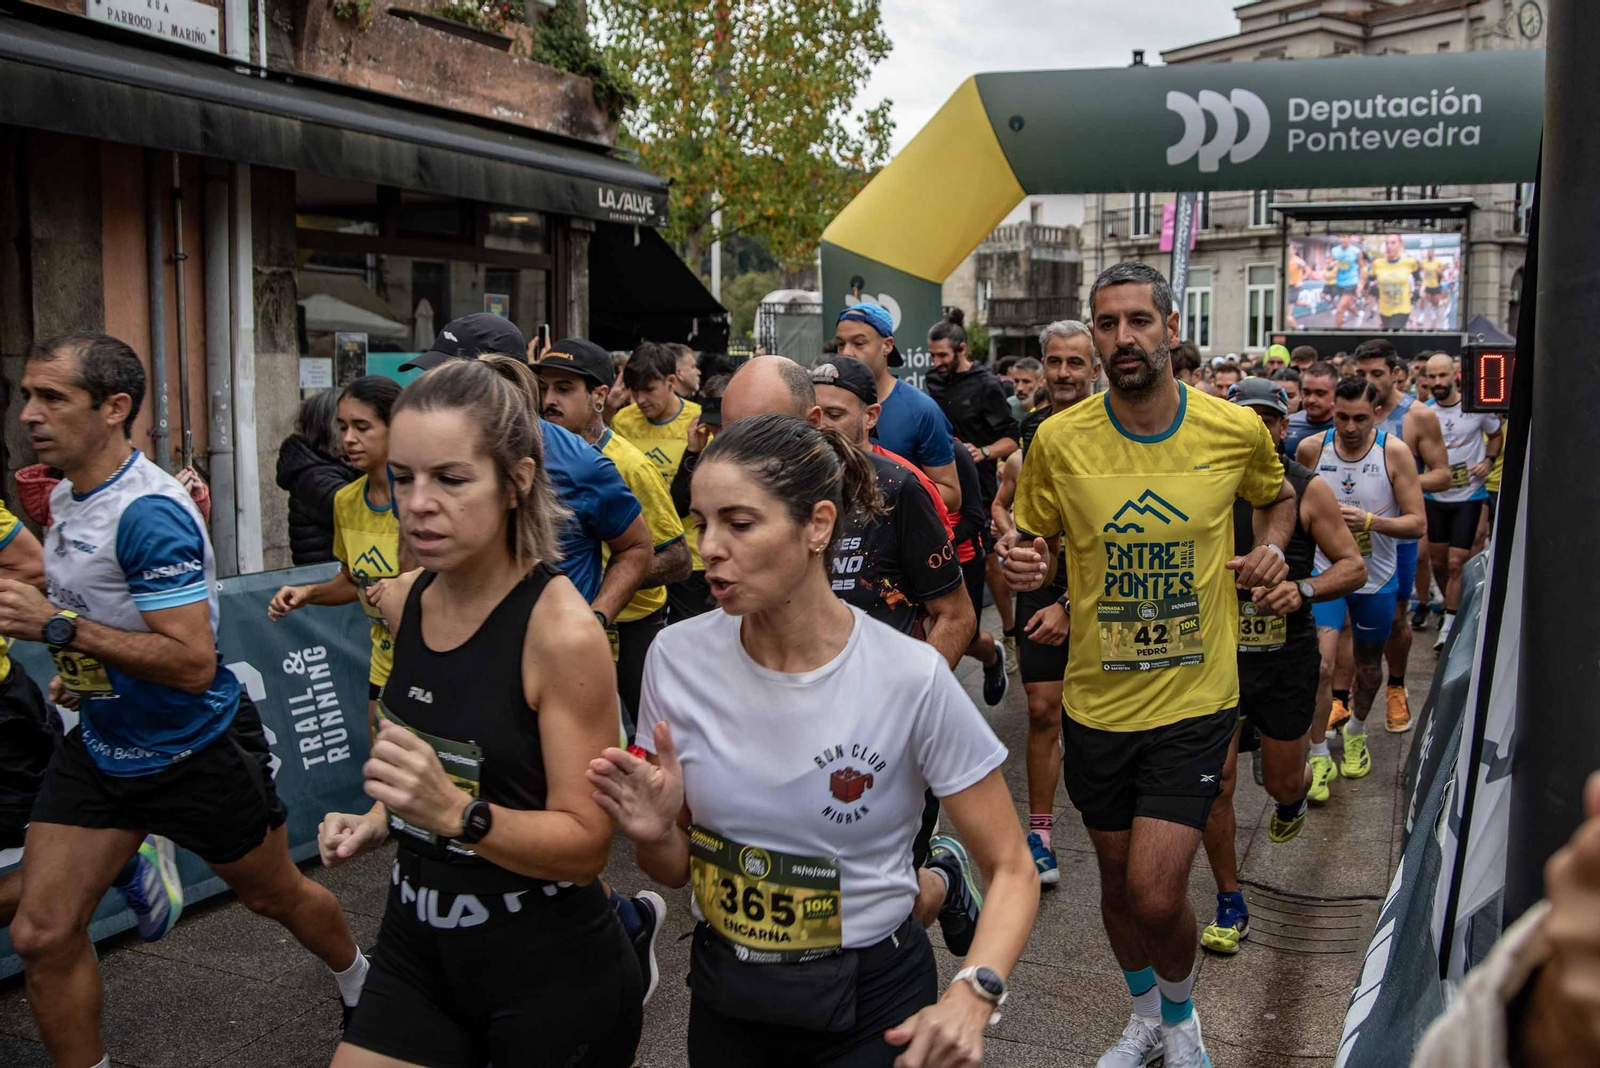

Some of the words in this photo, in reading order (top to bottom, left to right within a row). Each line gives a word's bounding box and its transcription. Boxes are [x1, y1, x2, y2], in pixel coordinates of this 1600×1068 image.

[107, 7, 152, 29] PARROCO
[157, 21, 166, 34] J.
[170, 24, 206, 44] MARIÑO
[1288, 86, 1482, 128] Deputación
[1288, 121, 1481, 152] Pontevedra
[1104, 540, 1180, 570] ENTRE
[1180, 550, 1188, 569] TRAIL
[1187, 540, 1195, 569] RUNNING
[1104, 571, 1195, 600] PONTES
[1134, 624, 1169, 647] 42
[1180, 619, 1197, 630] 10K
[1241, 619, 1266, 635] 30
[282, 651, 306, 675] &
[1136, 647, 1168, 656] PEDRO
[303, 644, 351, 764] RUNNING
[408, 686, 433, 703] FILA
[289, 688, 326, 771] TRAIL
[814, 744, 844, 769] RUN
[852, 743, 887, 772] CLUB
[720, 878, 796, 927] 365
[804, 898, 834, 913] 10K
